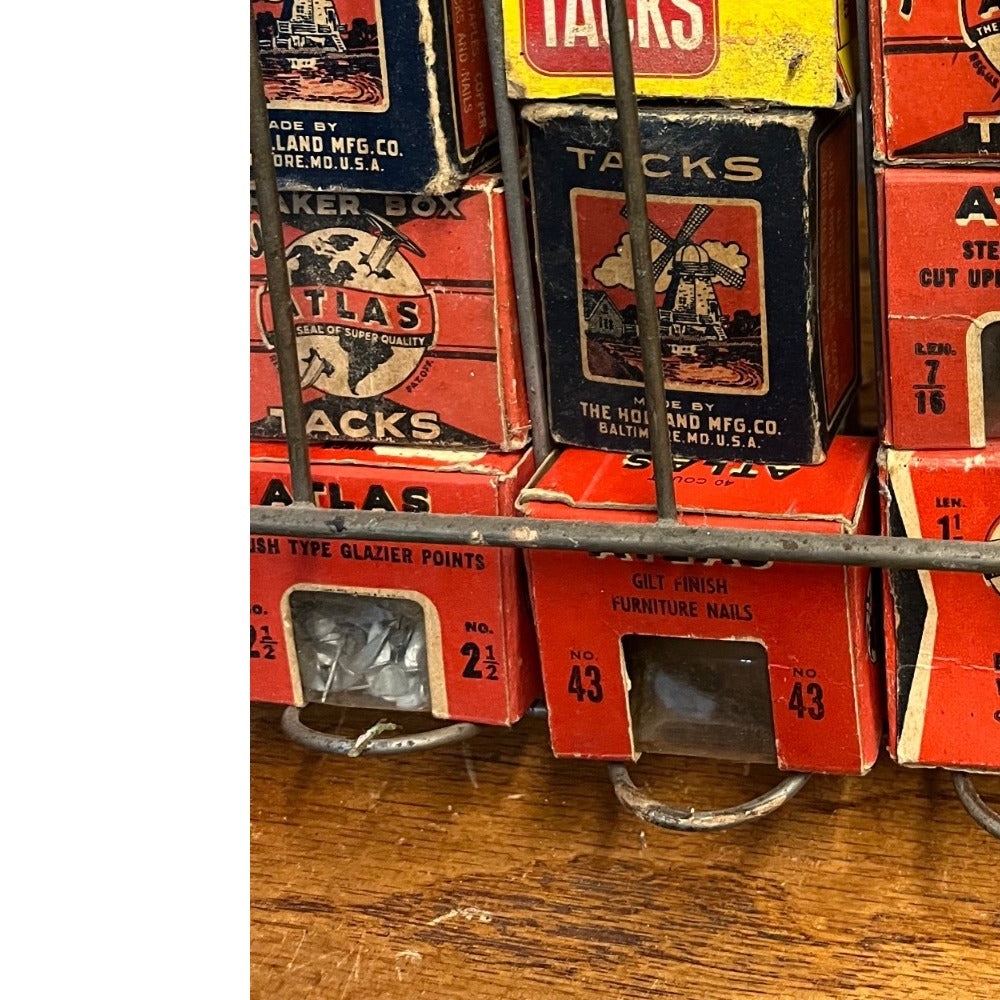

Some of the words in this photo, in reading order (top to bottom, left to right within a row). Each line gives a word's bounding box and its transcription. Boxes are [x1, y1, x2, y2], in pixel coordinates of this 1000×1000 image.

[976, 23, 999, 36] THE
[269, 120, 305, 131] ADE
[313, 121, 338, 132] BY
[386, 195, 463, 217] BOX
[919, 268, 959, 289] CUT
[296, 324, 325, 335] SEAL
[344, 327, 379, 342] SUPER
[380, 334, 426, 347] QUALITY
[580, 401, 612, 420] THE
[691, 402, 715, 413] BY
[714, 479, 735, 487] 40
[935, 496, 967, 509] LEN.
[288, 539, 333, 558] TYPE
[340, 543, 413, 564] GLAZIER
[422, 549, 486, 571] POINTS
[631, 572, 665, 591] GILT
[673, 575, 729, 595] FINISH
[611, 596, 699, 618] FURNITURE
[706, 602, 754, 622] NAILS
[465, 621, 494, 635] NO.
[567, 664, 604, 704] 43
[788, 681, 825, 721] 43
